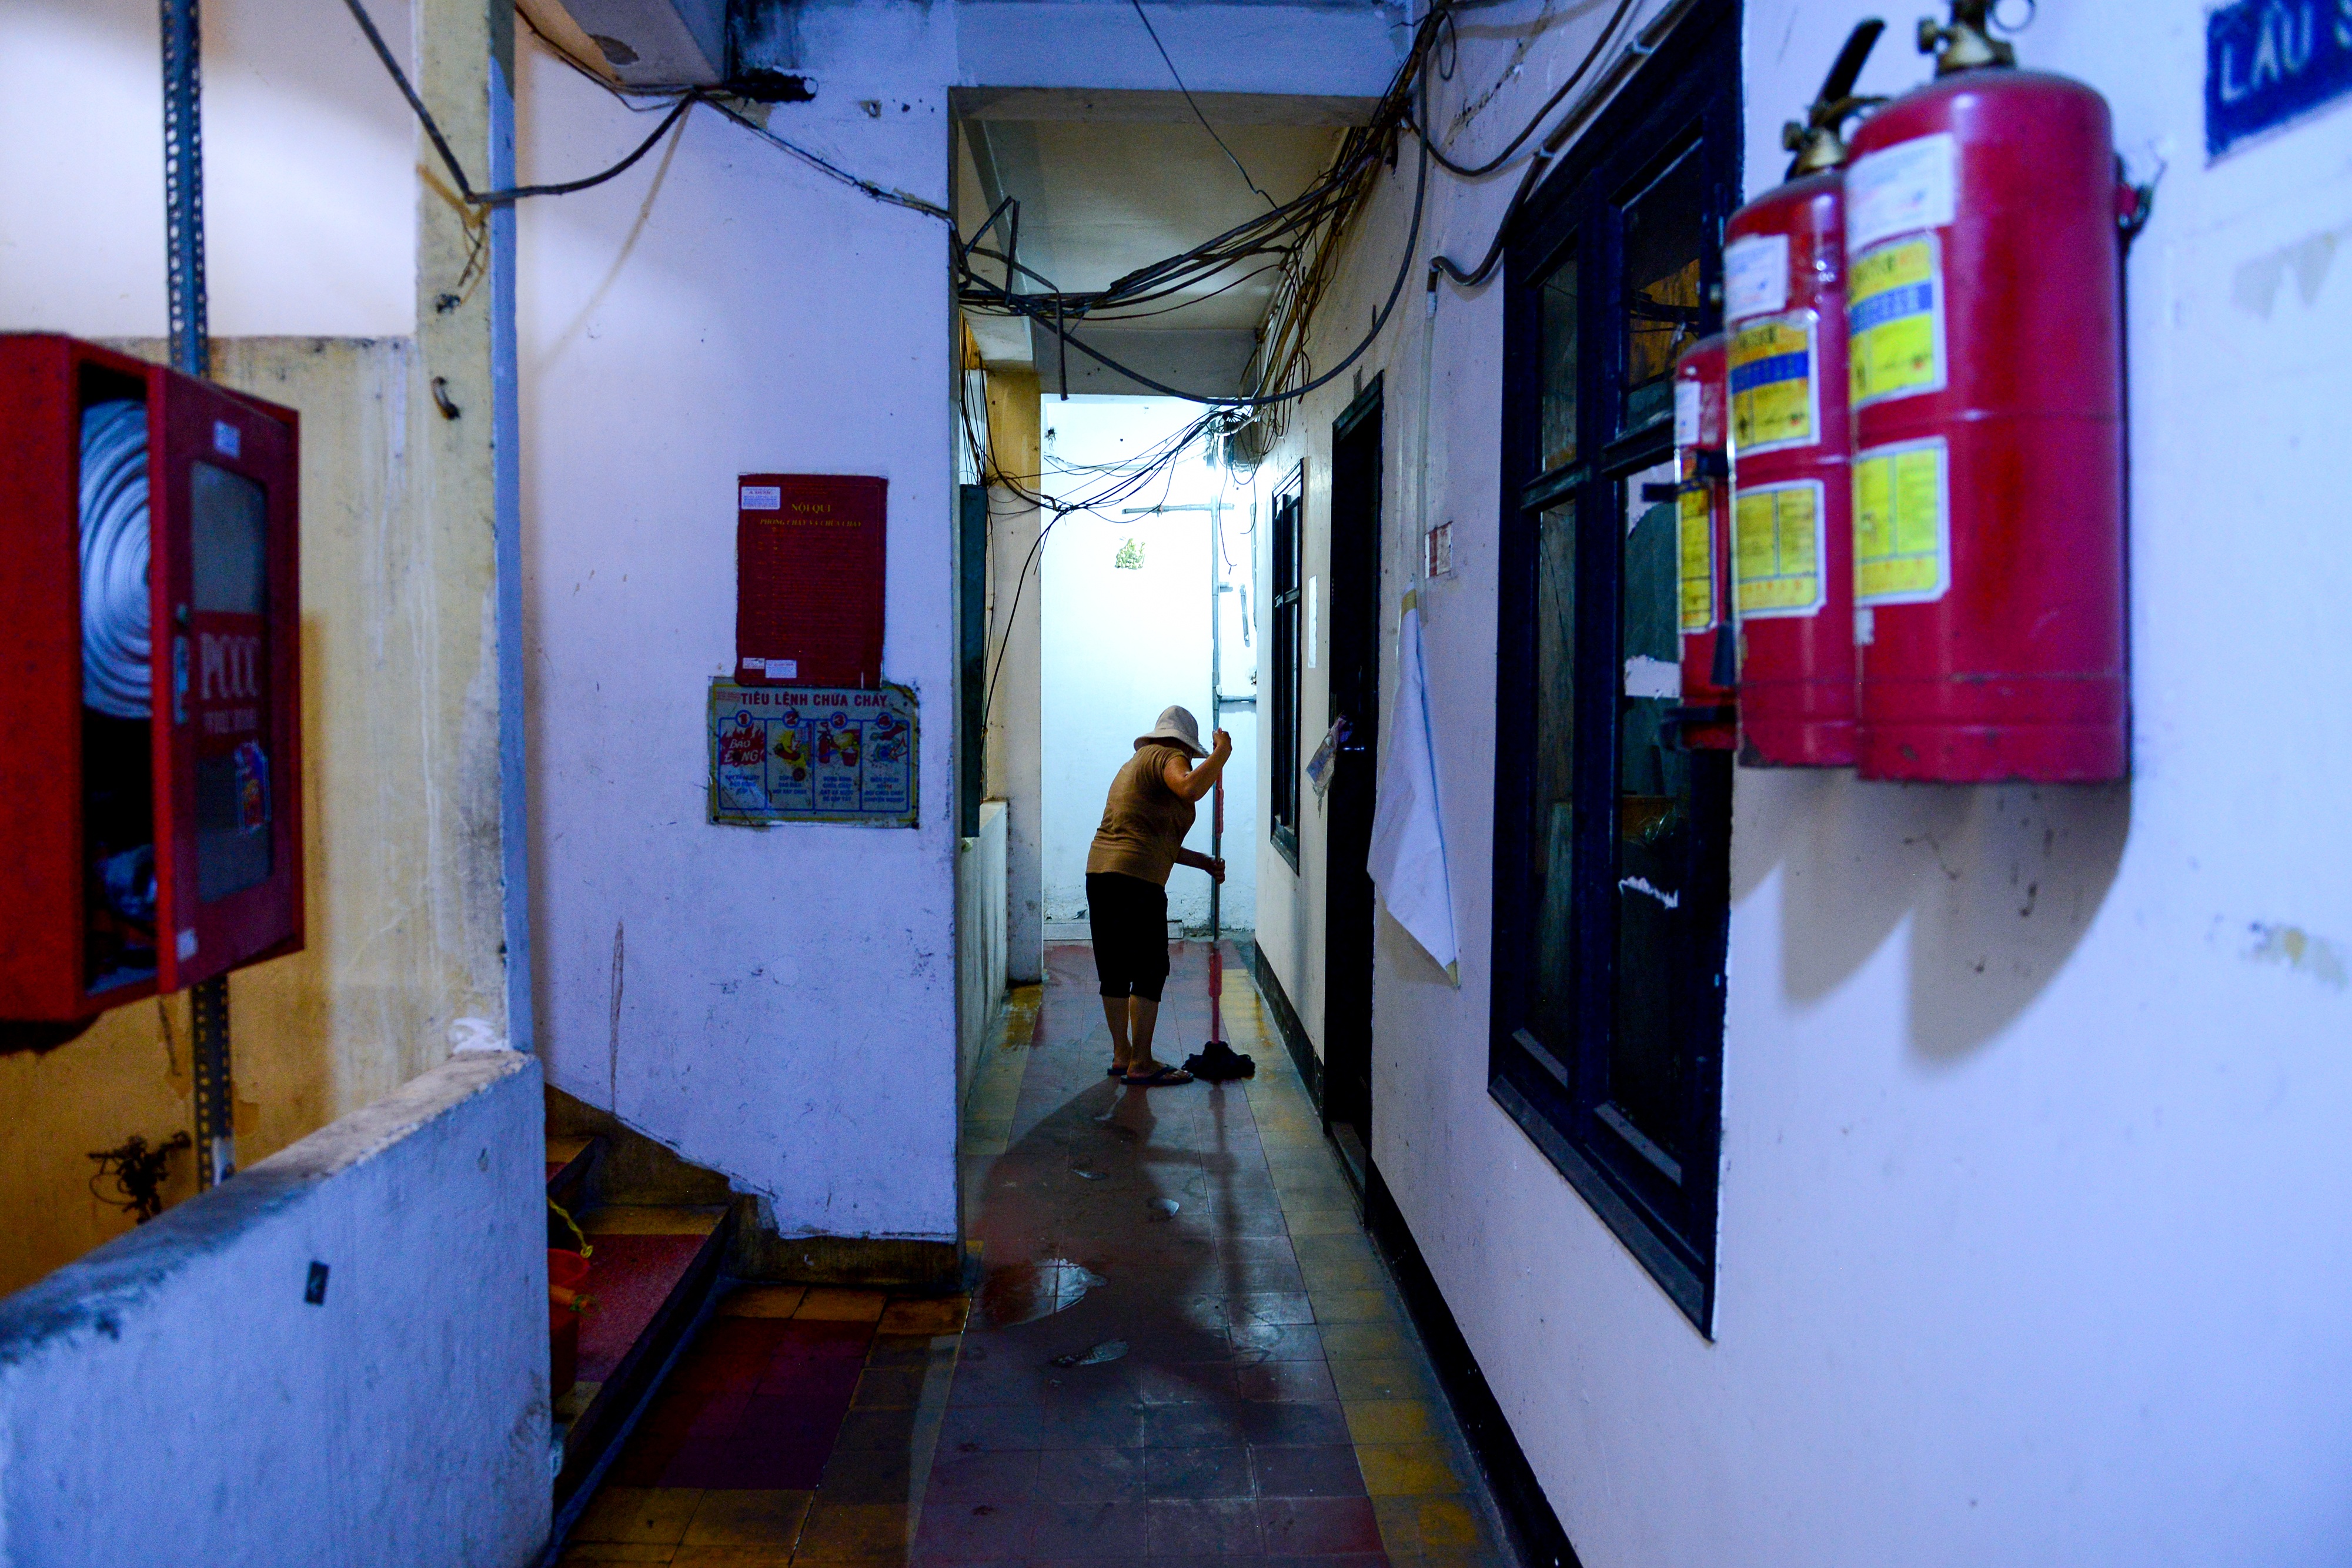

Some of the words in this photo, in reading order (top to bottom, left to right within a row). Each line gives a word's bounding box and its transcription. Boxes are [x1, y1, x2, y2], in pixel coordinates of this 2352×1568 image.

[741, 691, 770, 705] TIÊU
[775, 691, 808, 706] LỆNH
[854, 693, 888, 707] CHÁY
[739, 713, 747, 725] 1
[786, 713, 797, 725] 2
[834, 714, 844, 727] 3
[724, 750, 759, 763] ĐNG
